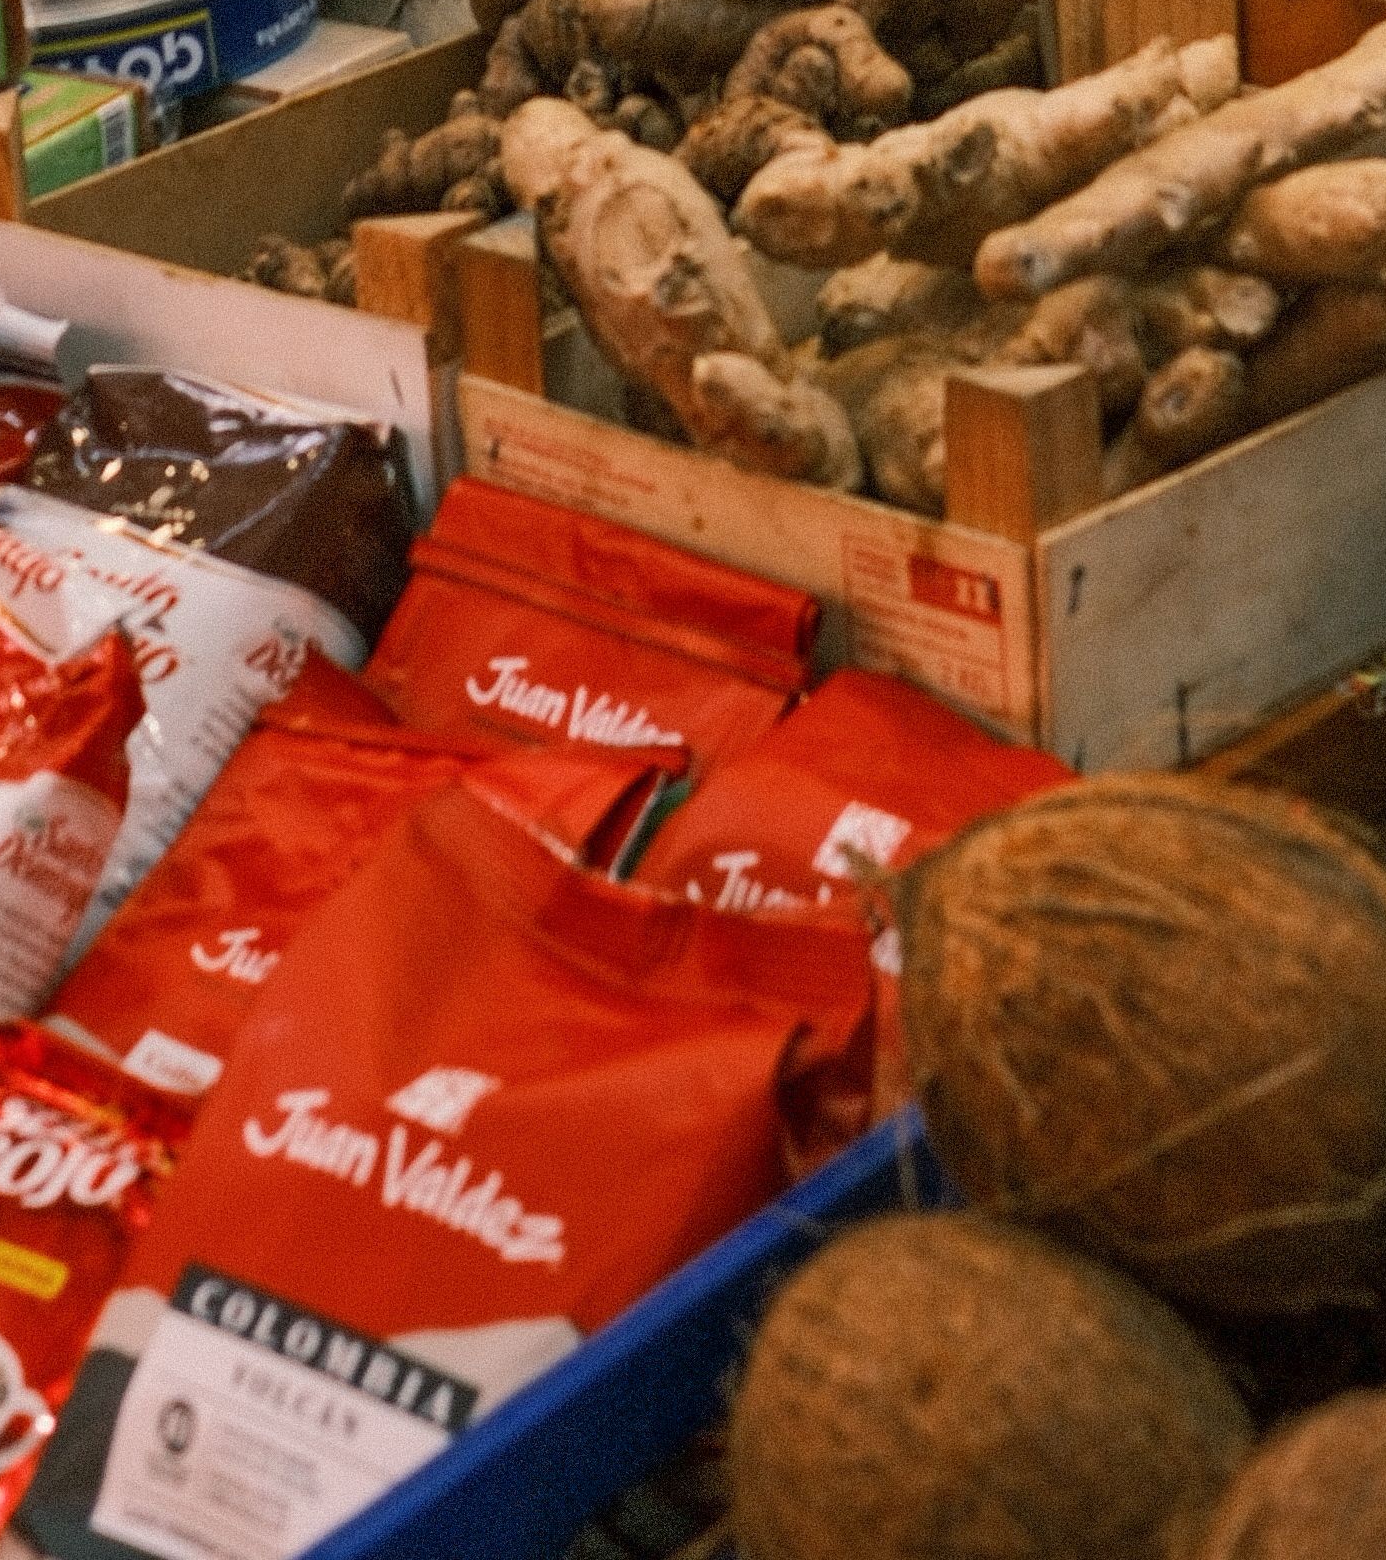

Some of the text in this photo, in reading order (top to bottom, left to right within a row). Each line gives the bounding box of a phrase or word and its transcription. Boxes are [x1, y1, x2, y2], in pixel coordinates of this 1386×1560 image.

[465, 652, 570, 728] Juan
[242, 1088, 567, 1266] Juan Valdez
[189, 1276, 463, 1423] COLOMBIA
